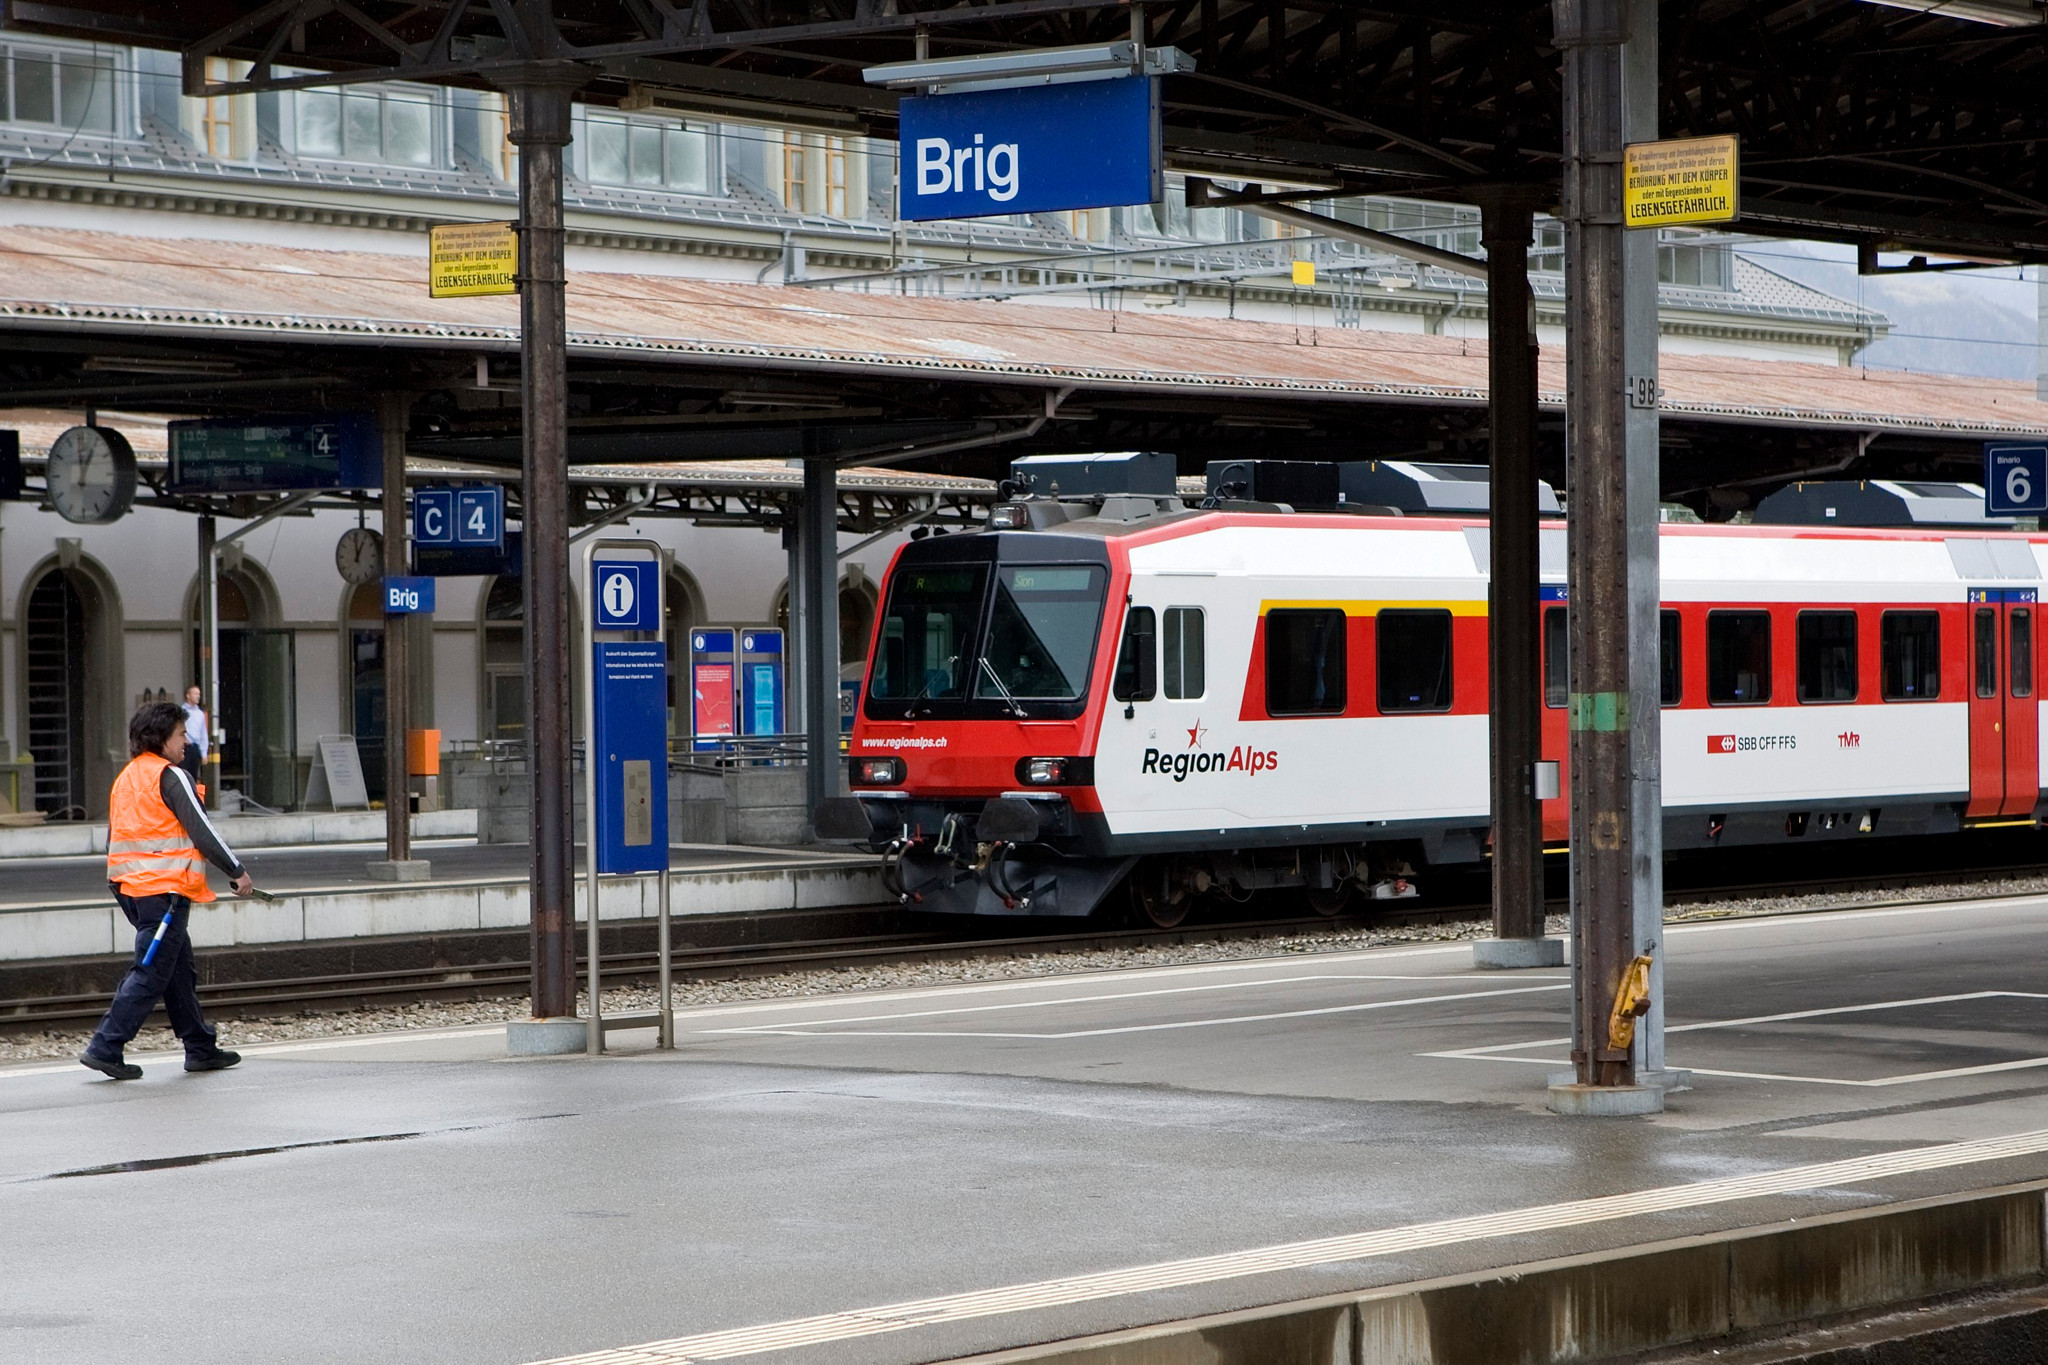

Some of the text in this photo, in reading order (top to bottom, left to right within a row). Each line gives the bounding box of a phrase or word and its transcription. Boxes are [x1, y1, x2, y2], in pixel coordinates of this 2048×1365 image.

[1717, 145, 1731, 154] oder
[917, 133, 1019, 202] Brig
[1640, 162, 1655, 172] Boden
[1656, 161, 1678, 172] liegende
[1698, 157, 1708, 167] und
[1708, 157, 1725, 166] deren
[1629, 168, 1728, 189] BERÜHRUNG MIT DEM KÖRPER
[1642, 184, 1712, 199] oder mit Gegenständen ist
[1630, 196, 1730, 219] LEBENSGEFÄHRLICH.
[464, 251, 474, 261] MIT
[475, 250, 487, 261] DEM
[488, 249, 512, 260] KÖRPER
[1638, 377, 1655, 405] 98
[318, 434, 331, 454] 4
[1997, 456, 2021, 464] Binario
[2005, 466, 2031, 503] 6
[424, 507, 443, 536] C
[467, 506, 486, 535] 4
[916, 578, 925, 589] R
[1014, 575, 1035, 588] Sion
[389, 588, 419, 610] Brig
[1970, 591, 1975, 603] 2
[2031, 591, 2036, 602] 2
[862, 736, 948, 750] www.regionalps.ch
[1738, 735, 1797, 751] SBB CFF FFS
[1837, 731, 1860, 748] TMR
[1141, 746, 1278, 783] RegionAlps
